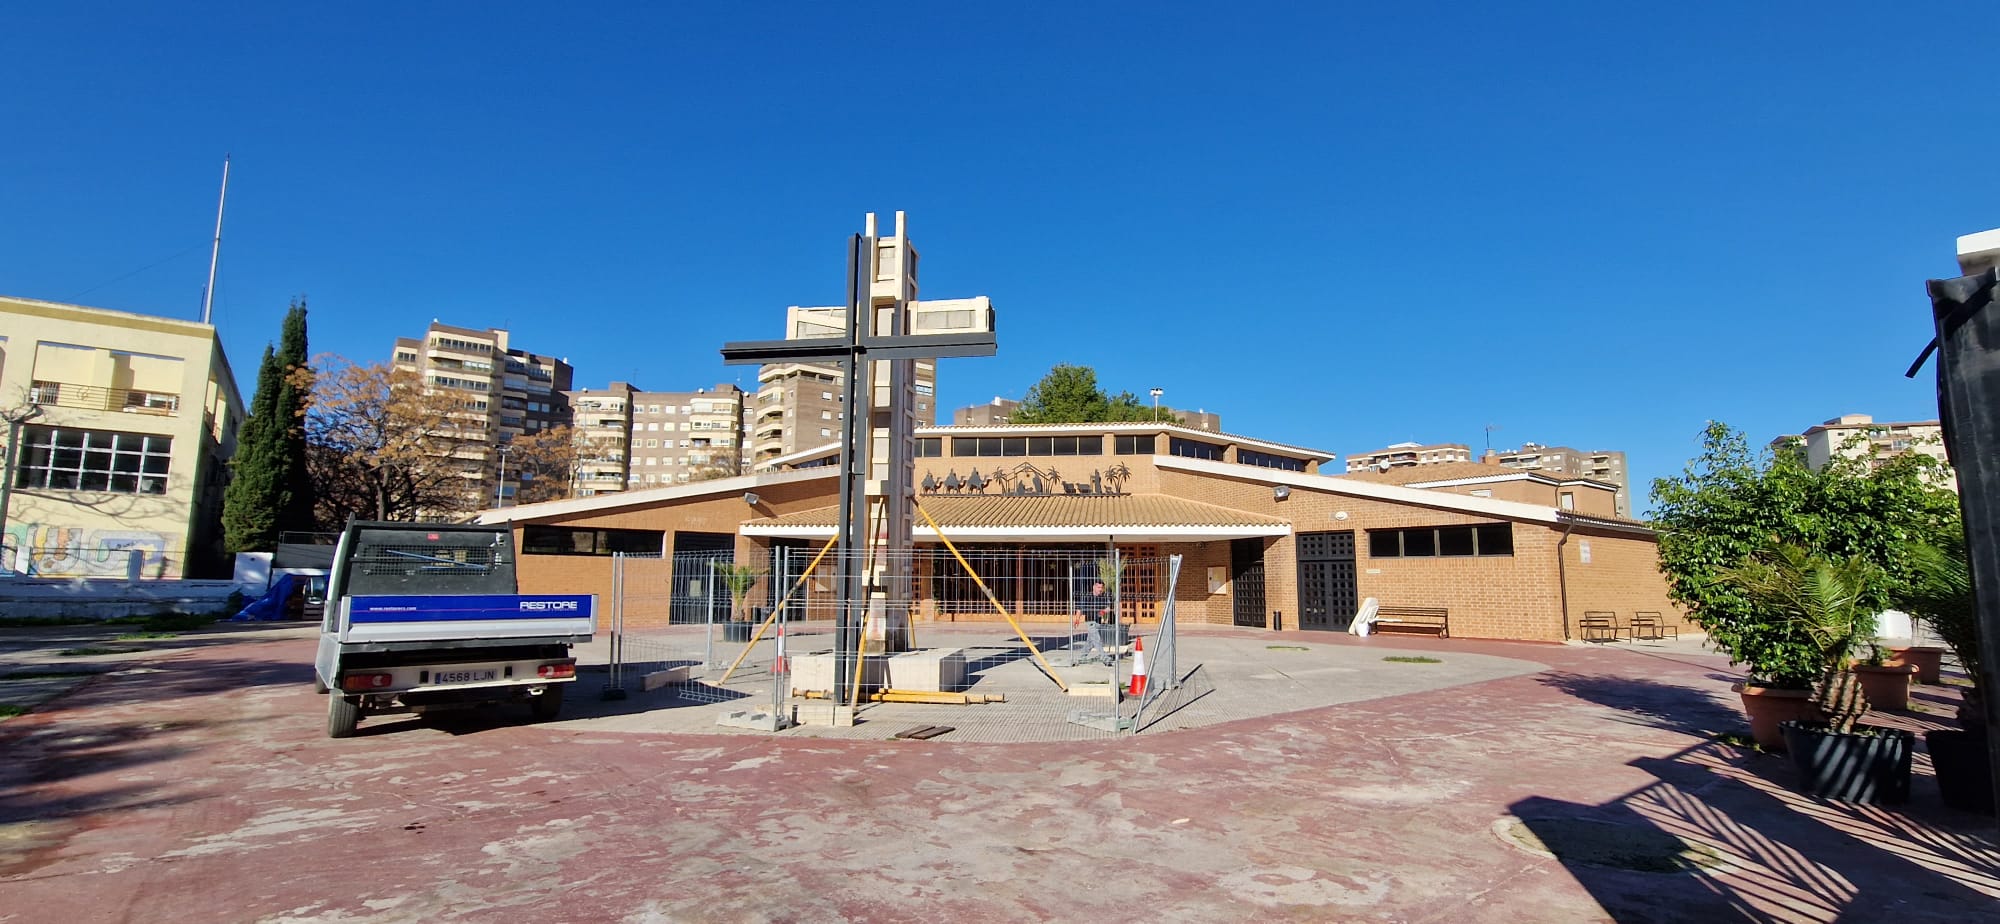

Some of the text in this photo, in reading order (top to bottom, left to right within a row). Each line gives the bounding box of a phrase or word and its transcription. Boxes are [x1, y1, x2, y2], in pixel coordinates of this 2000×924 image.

[520, 602, 578, 610] RESTORE
[442, 671, 494, 683] 4568 LJN
